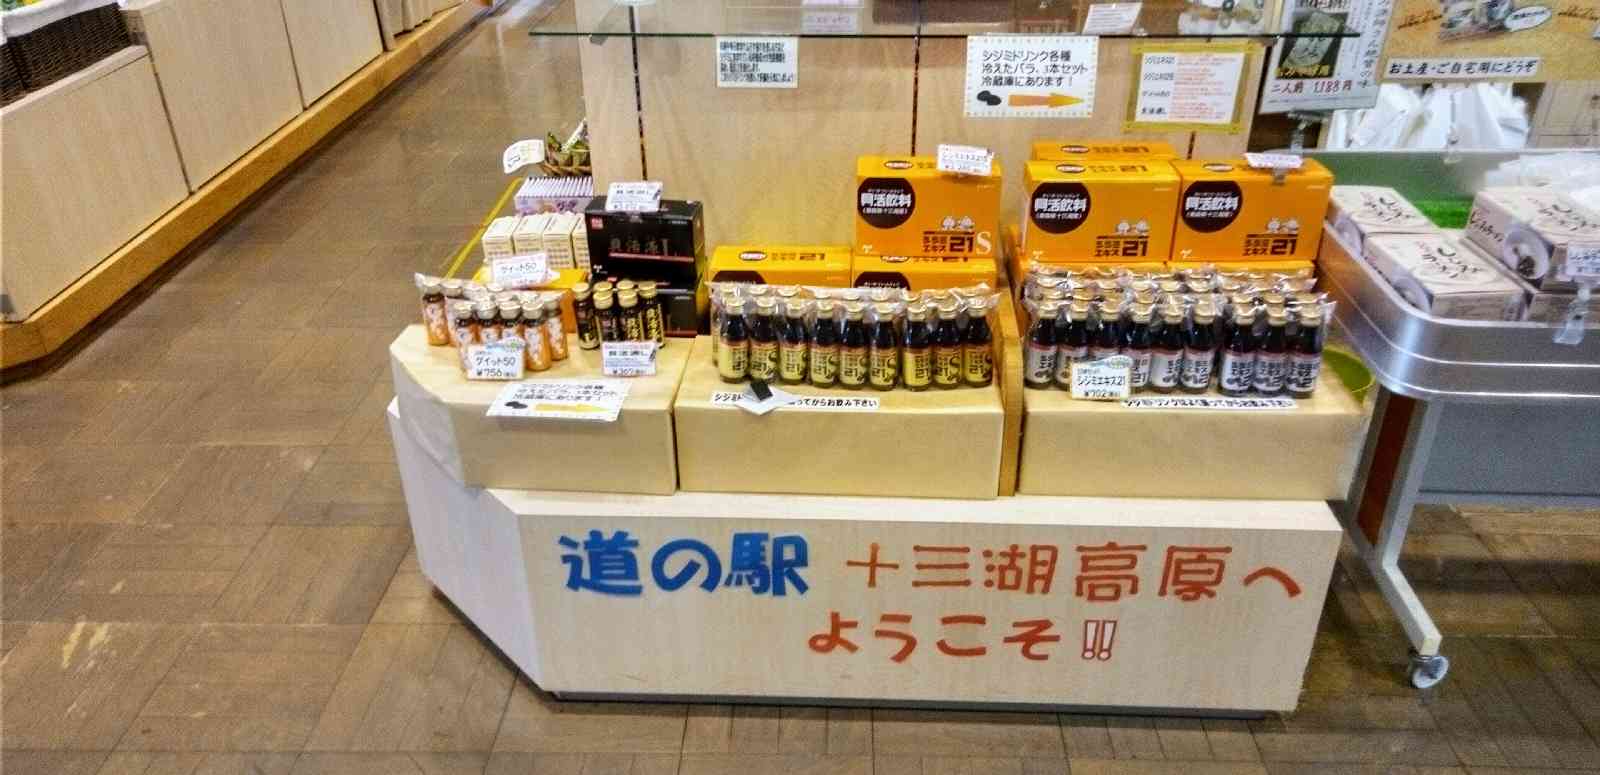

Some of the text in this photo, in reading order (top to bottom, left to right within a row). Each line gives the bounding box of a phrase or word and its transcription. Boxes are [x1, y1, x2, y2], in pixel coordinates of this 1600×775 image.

[949, 231, 992, 255] 21 S
[1121, 240, 1149, 257] 21
[1270, 238, 1298, 255] 21
[558, 529, 1302, 602] 道の駅 十三湖高原へ
